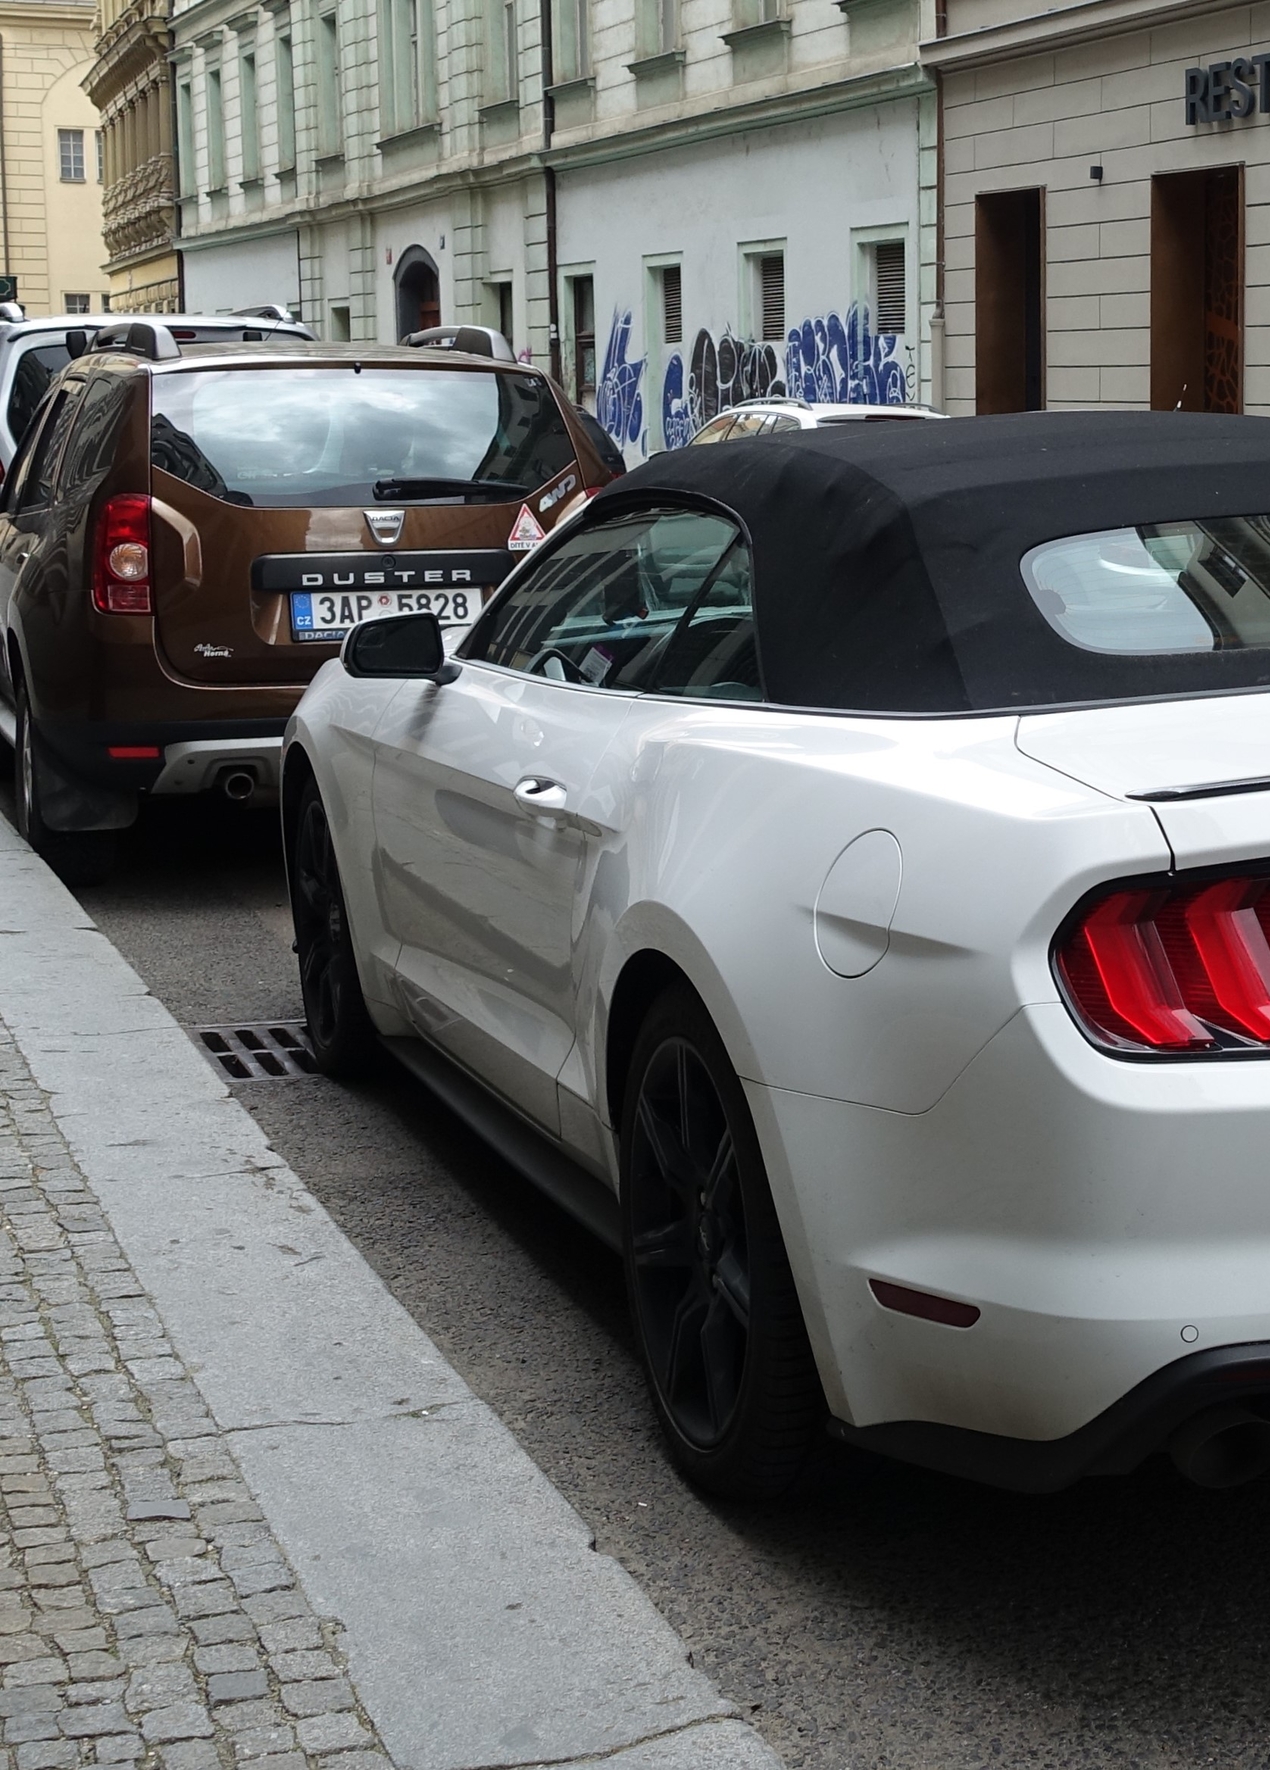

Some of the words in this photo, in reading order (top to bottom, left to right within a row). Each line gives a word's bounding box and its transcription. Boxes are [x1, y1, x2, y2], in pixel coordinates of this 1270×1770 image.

[302, 569, 472, 586] DUSTER
[319, 594, 373, 625] 3AP
[396, 591, 469, 621] 5828
[296, 616, 312, 626] CZ
